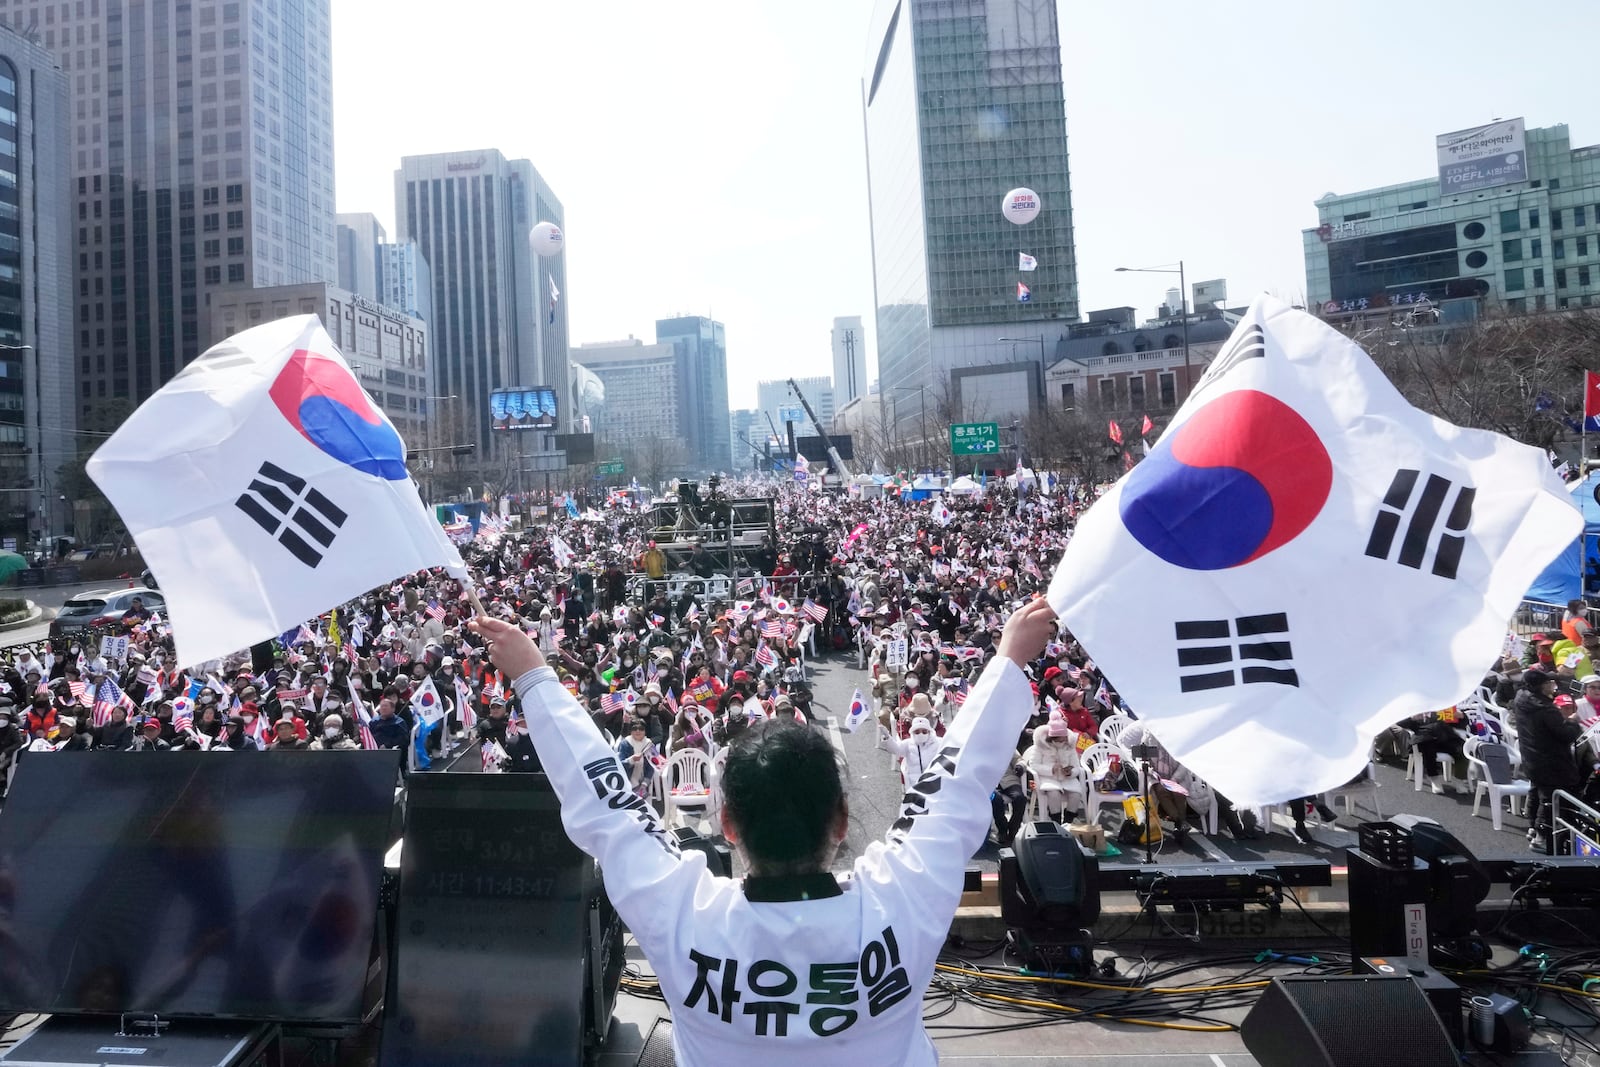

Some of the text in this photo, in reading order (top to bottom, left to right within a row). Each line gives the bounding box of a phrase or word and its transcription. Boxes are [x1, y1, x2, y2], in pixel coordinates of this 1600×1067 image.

[1446, 171, 1485, 184] TOEFL
[954, 425, 993, 437] 종로1가
[683, 925, 912, 1037] 자유통일
